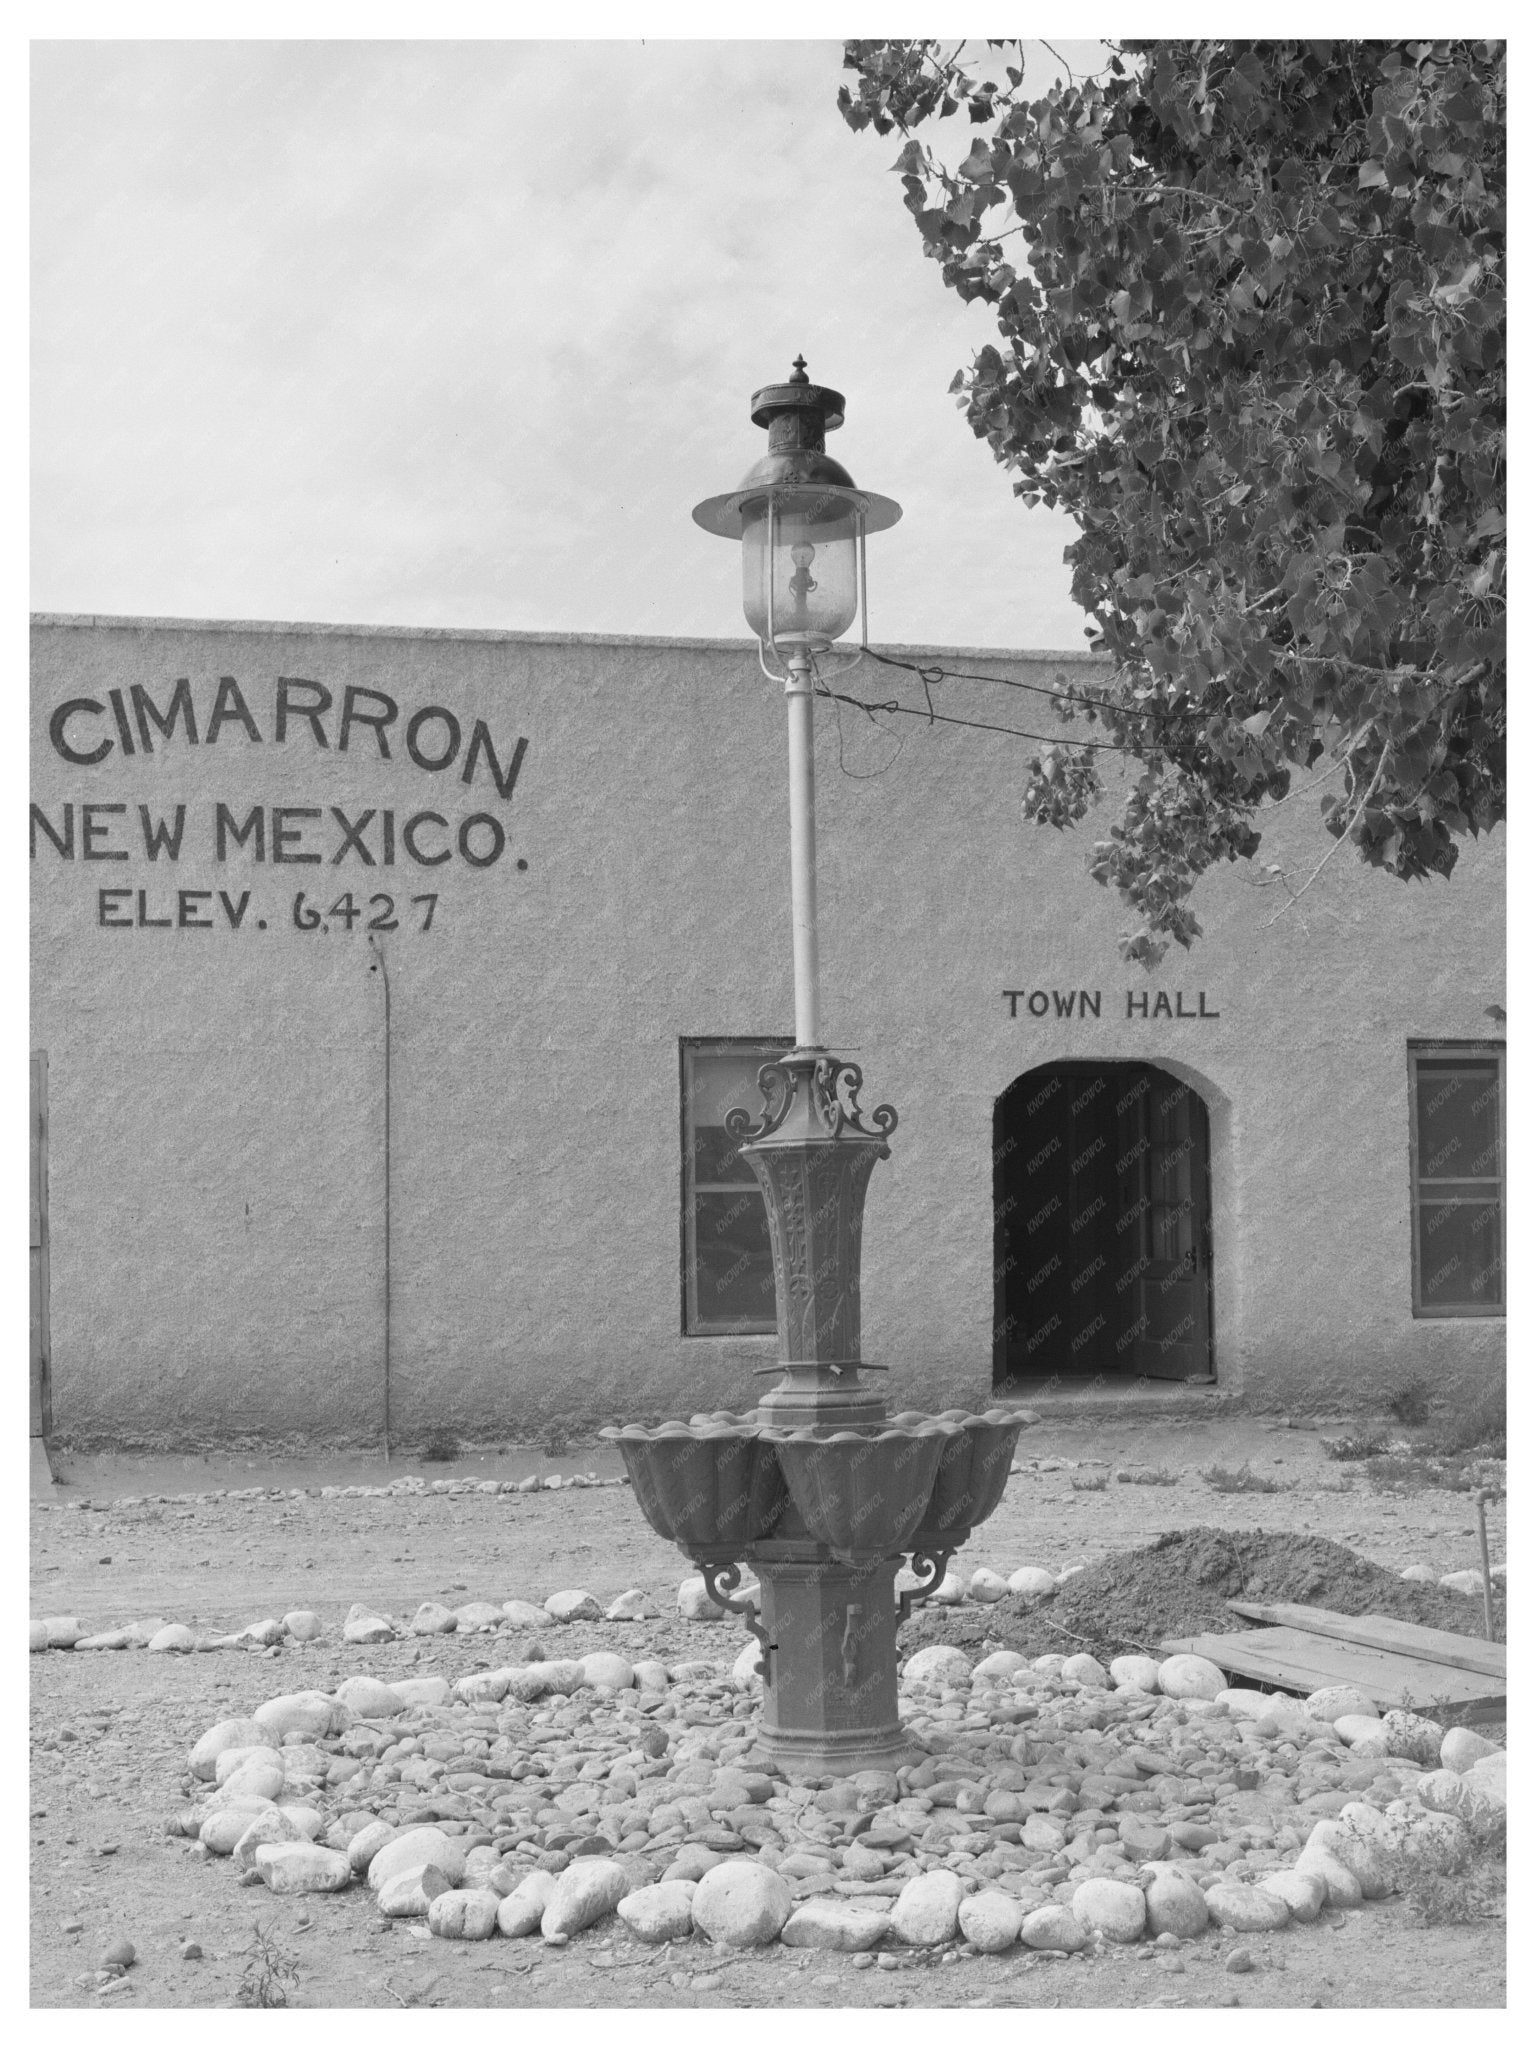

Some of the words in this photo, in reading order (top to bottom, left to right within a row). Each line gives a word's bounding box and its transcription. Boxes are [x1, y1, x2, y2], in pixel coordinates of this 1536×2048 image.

[49, 677, 529, 801] CIMARRON
[30, 803, 186, 861] NEW
[216, 803, 528, 871] MEXICO.
[99, 889, 267, 929] ELEV.
[1002, 990, 1102, 1018] TOWN
[1126, 991, 1220, 1018] HALL
